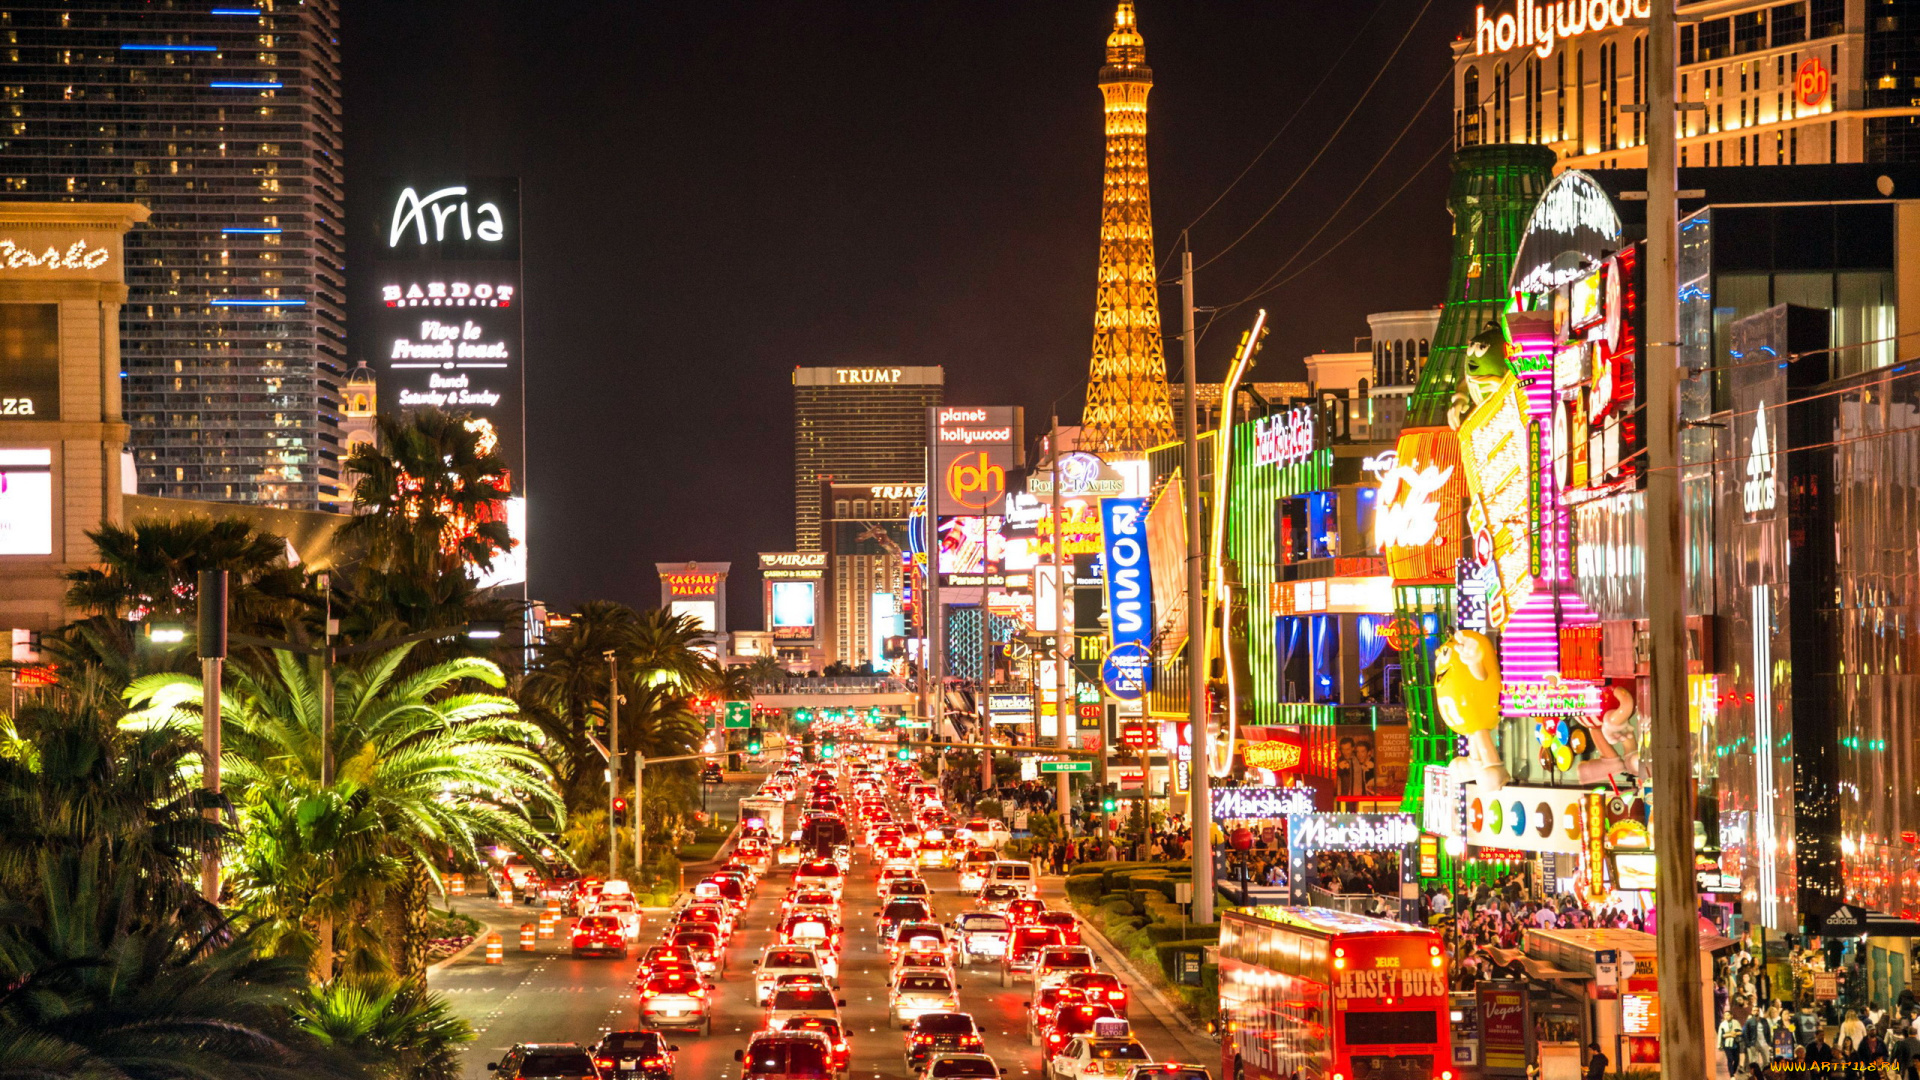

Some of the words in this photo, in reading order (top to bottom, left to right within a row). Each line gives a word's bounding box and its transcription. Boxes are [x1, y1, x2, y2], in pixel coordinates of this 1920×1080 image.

[390, 187, 504, 247] Aria
[383, 282, 514, 301] BARDOT
[421, 321, 460, 340] Vive
[463, 321, 482, 340] le
[391, 340, 454, 358] French
[429, 373, 469, 388] Brunch
[837, 369, 902, 383] TRUMP
[0, 397, 36, 415] za
[399, 390, 447, 406] Saturday
[447, 392, 458, 404] &
[458, 390, 500, 406] Sunday
[940, 408, 986, 424] planet
[940, 428, 1010, 444] hollywood
[954, 452, 1005, 500] ph
[1530, 423, 1539, 520] MARGARITAS
[1073, 478, 1122, 491] TOWERS
[775, 554, 825, 567] MIRAGE
[1112, 505, 1142, 633] ROSS
[668, 574, 716, 585] CAESARS
[949, 574, 1005, 585] Panasnic
[671, 585, 715, 595] PALACE
[1118, 668, 1142, 681] FOR
[1249, 746, 1298, 764] Denny's
[1215, 791, 1314, 816] Marshalls
[1590, 795, 1603, 838] FOOD
[1294, 816, 1408, 849] Marshall
[1591, 842, 1603, 895] COURT
[1826, 915, 1857, 925] adidas
[1335, 969, 1397, 998] JERSEY
[1401, 969, 1446, 997] BOYS
[1483, 1001, 1523, 1020] Vegas
